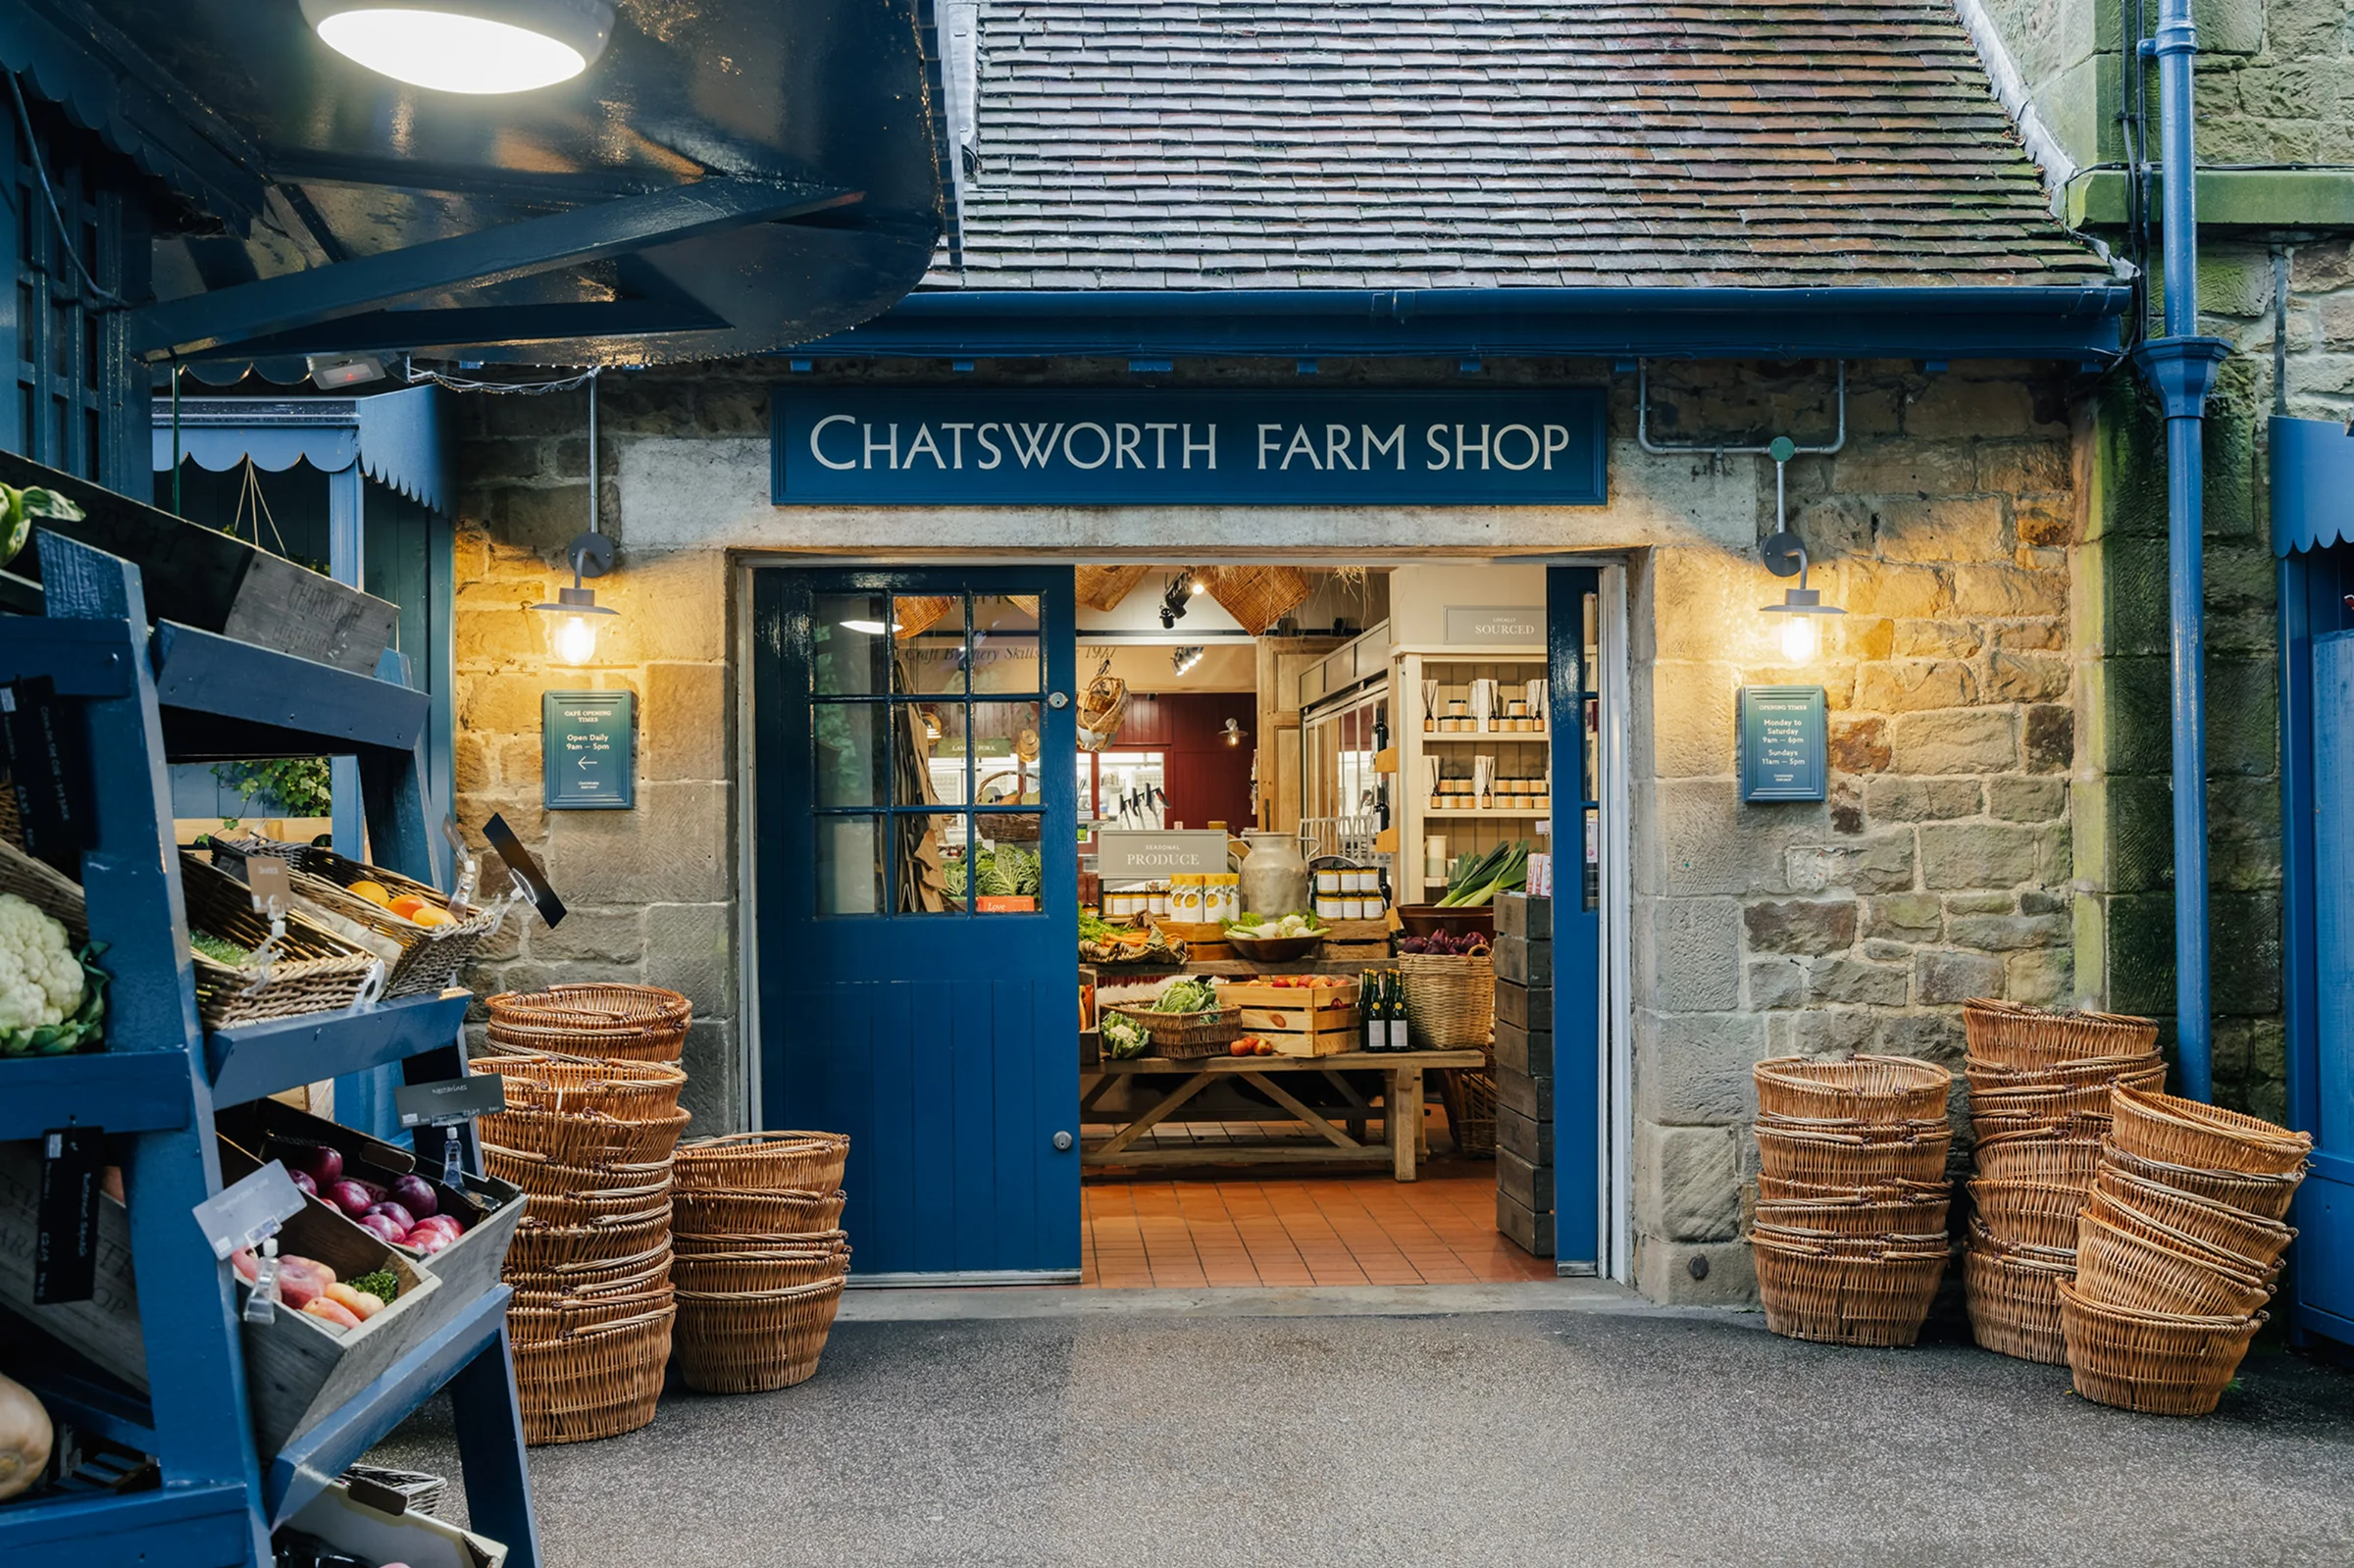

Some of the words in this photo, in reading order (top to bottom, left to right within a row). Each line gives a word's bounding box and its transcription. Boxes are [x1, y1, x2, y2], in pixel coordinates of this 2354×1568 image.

[809, 414, 1217, 471] CHATSWORTH
[1256, 422, 1407, 471] FARM
[1426, 423, 1570, 471] SHOP
[1474, 624, 1535, 634] SOURCED
[589, 733, 609, 742] Daily
[1127, 854, 1200, 866] PRODUCE
[987, 902, 1006, 913] Love
[432, 1084, 468, 1095] Nectarines
